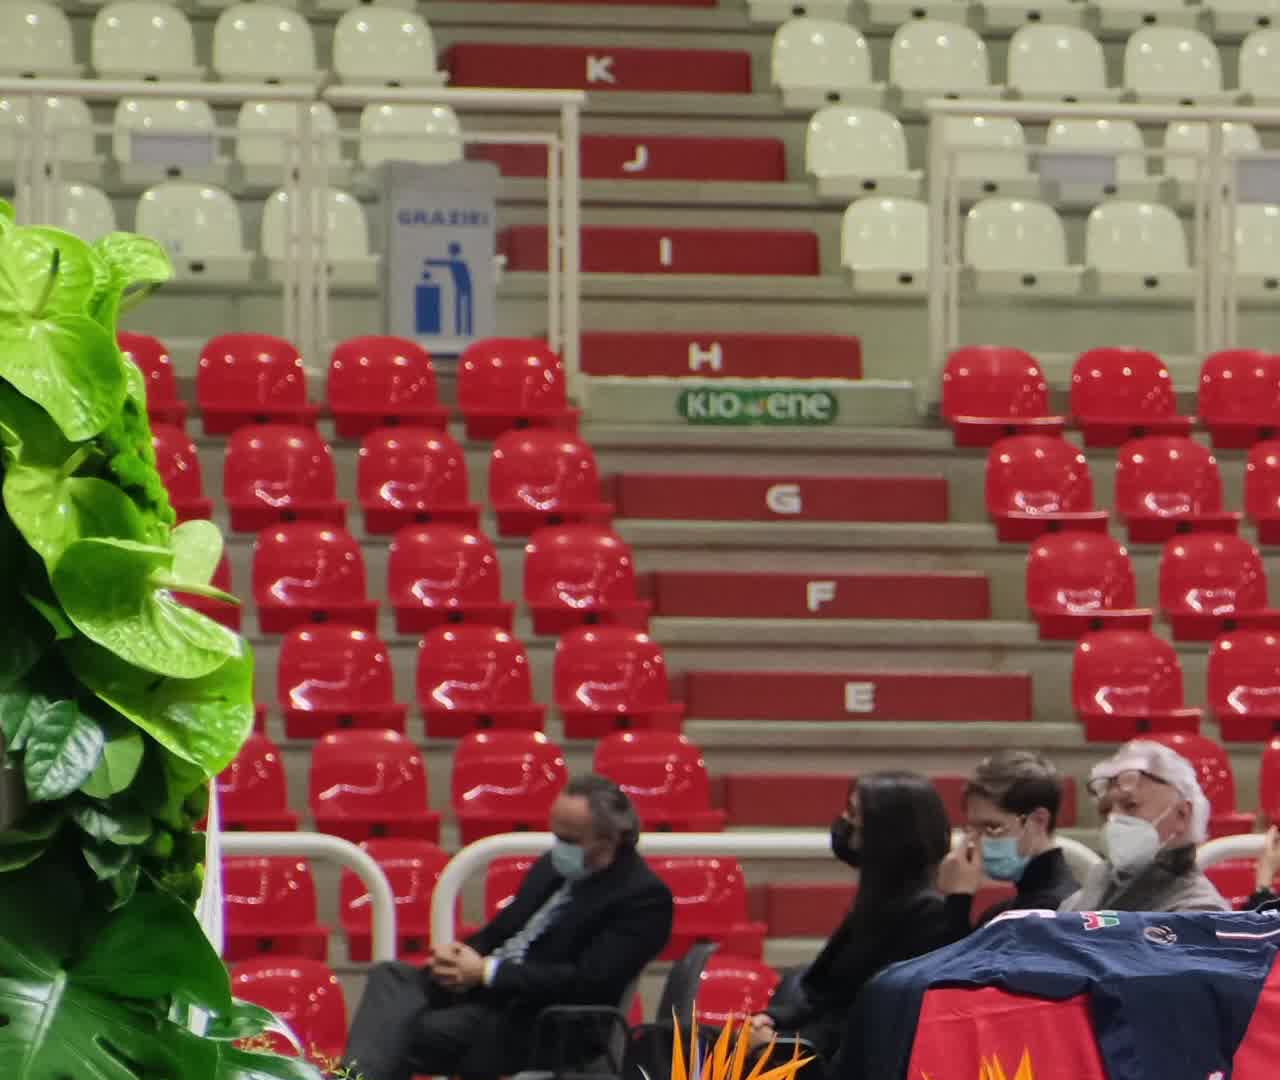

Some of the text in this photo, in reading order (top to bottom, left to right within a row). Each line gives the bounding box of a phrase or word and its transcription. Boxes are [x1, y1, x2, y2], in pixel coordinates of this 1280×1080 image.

[586, 56, 616, 83] K
[622, 144, 649, 172] J
[659, 237, 673, 266] I
[689, 342, 723, 371] H
[766, 483, 802, 514] G
[806, 580, 837, 612] F
[844, 681, 876, 713] E
